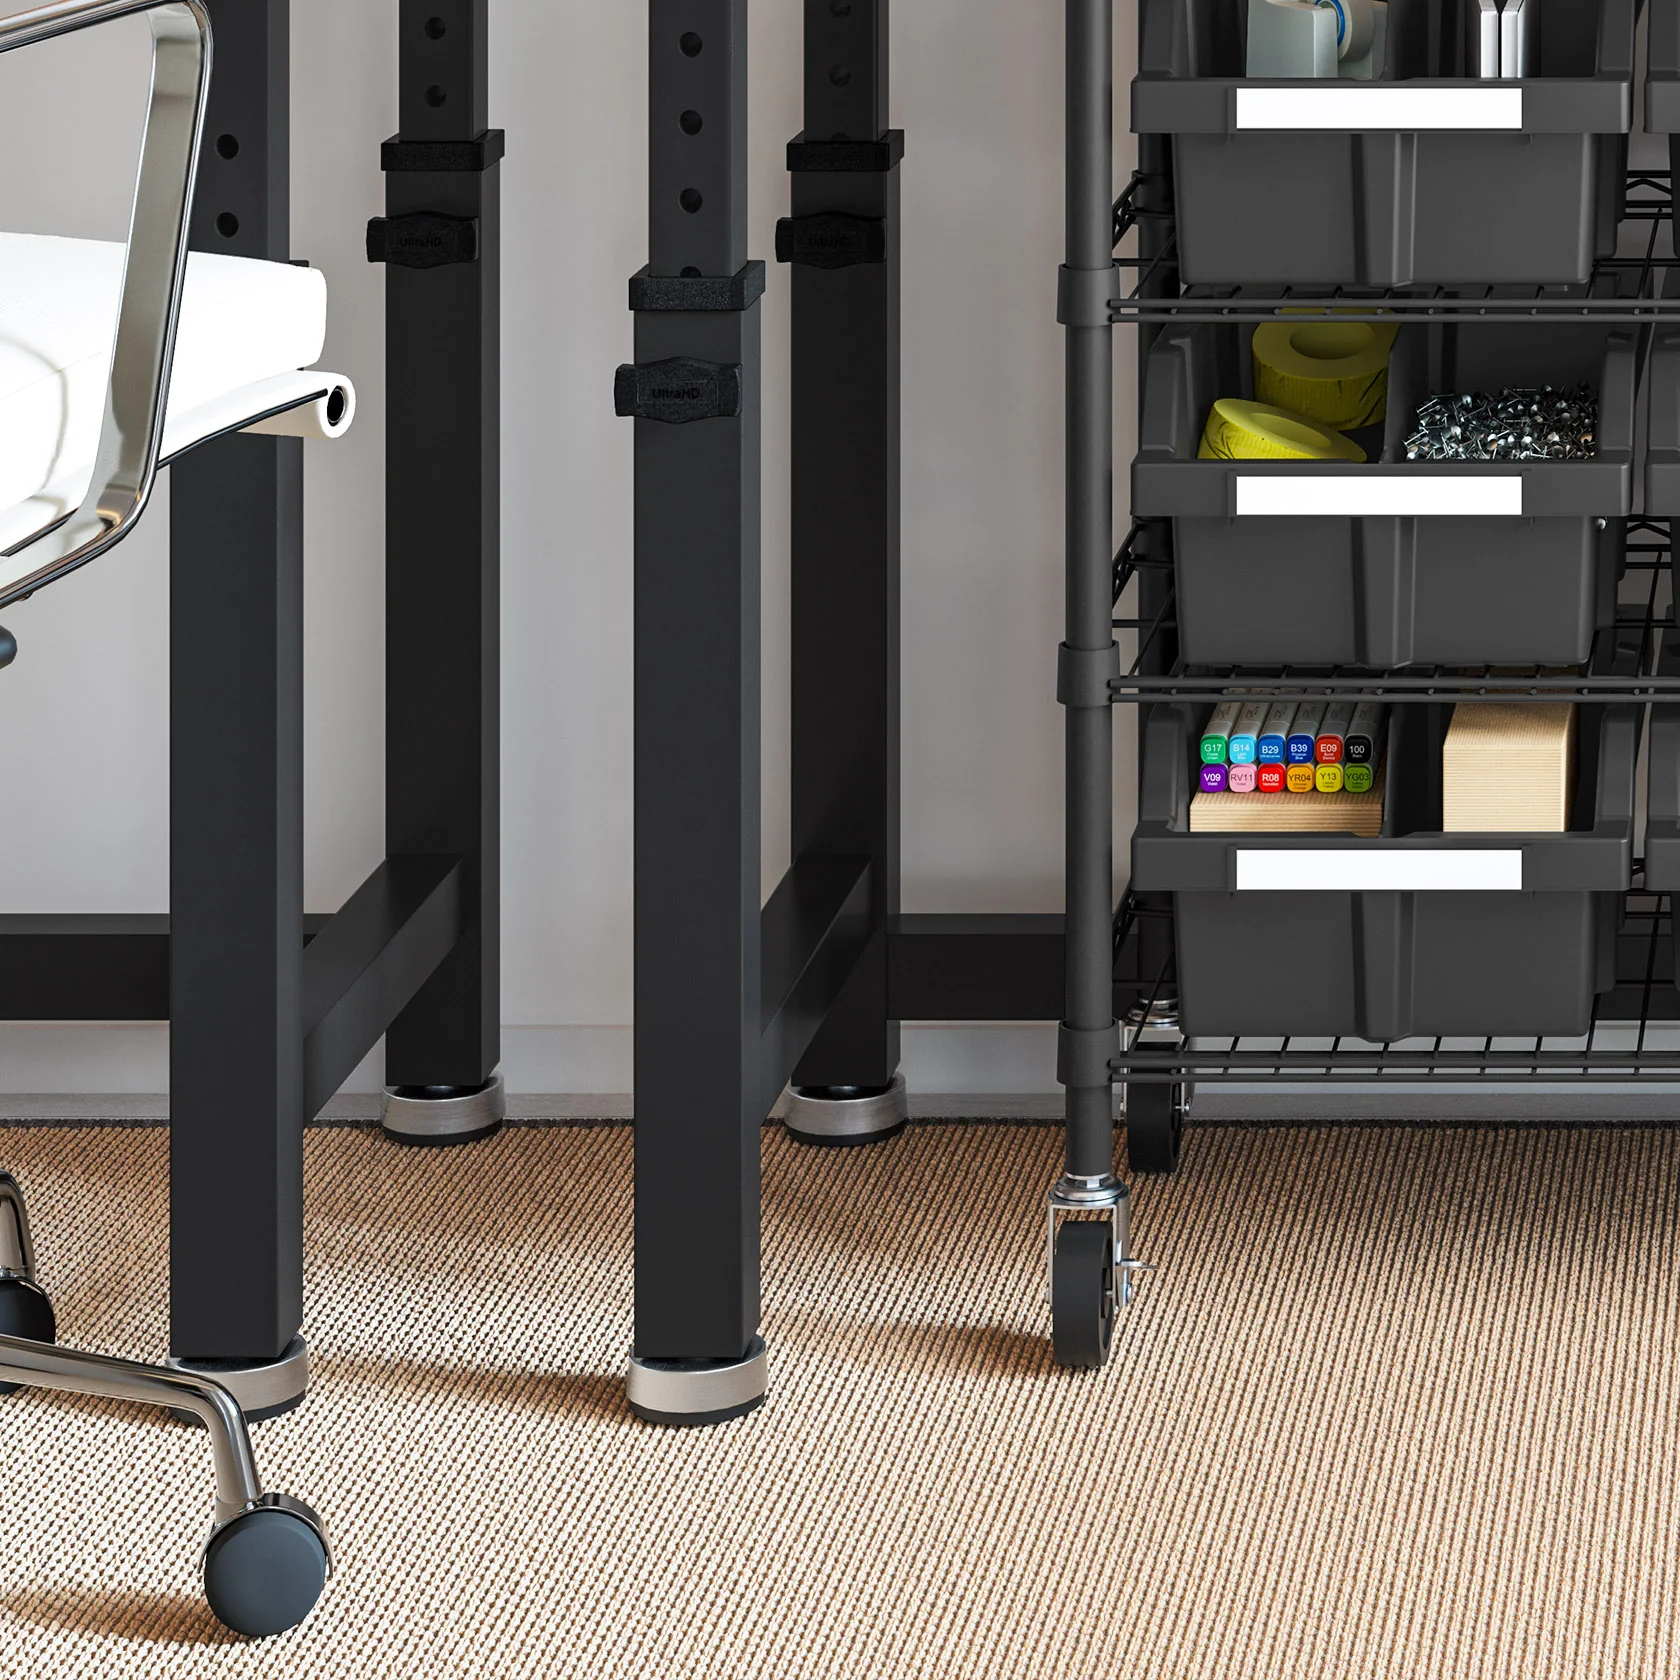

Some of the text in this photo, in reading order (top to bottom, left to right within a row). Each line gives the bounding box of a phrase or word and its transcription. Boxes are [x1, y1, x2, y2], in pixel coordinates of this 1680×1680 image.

[1204, 743, 1222, 752] G17
[1233, 743, 1250, 752] B14
[1261, 745, 1279, 754] B29
[1290, 743, 1308, 752] B39
[1320, 743, 1338, 752] E09
[1349, 745, 1365, 754] 100
[1203, 773, 1221, 782] V09
[1230, 773, 1253, 782] RV11
[1261, 773, 1280, 782] R08
[1288, 773, 1311, 782] YR04
[1320, 772, 1337, 781] Y13
[1346, 772, 1370, 781] YG03
